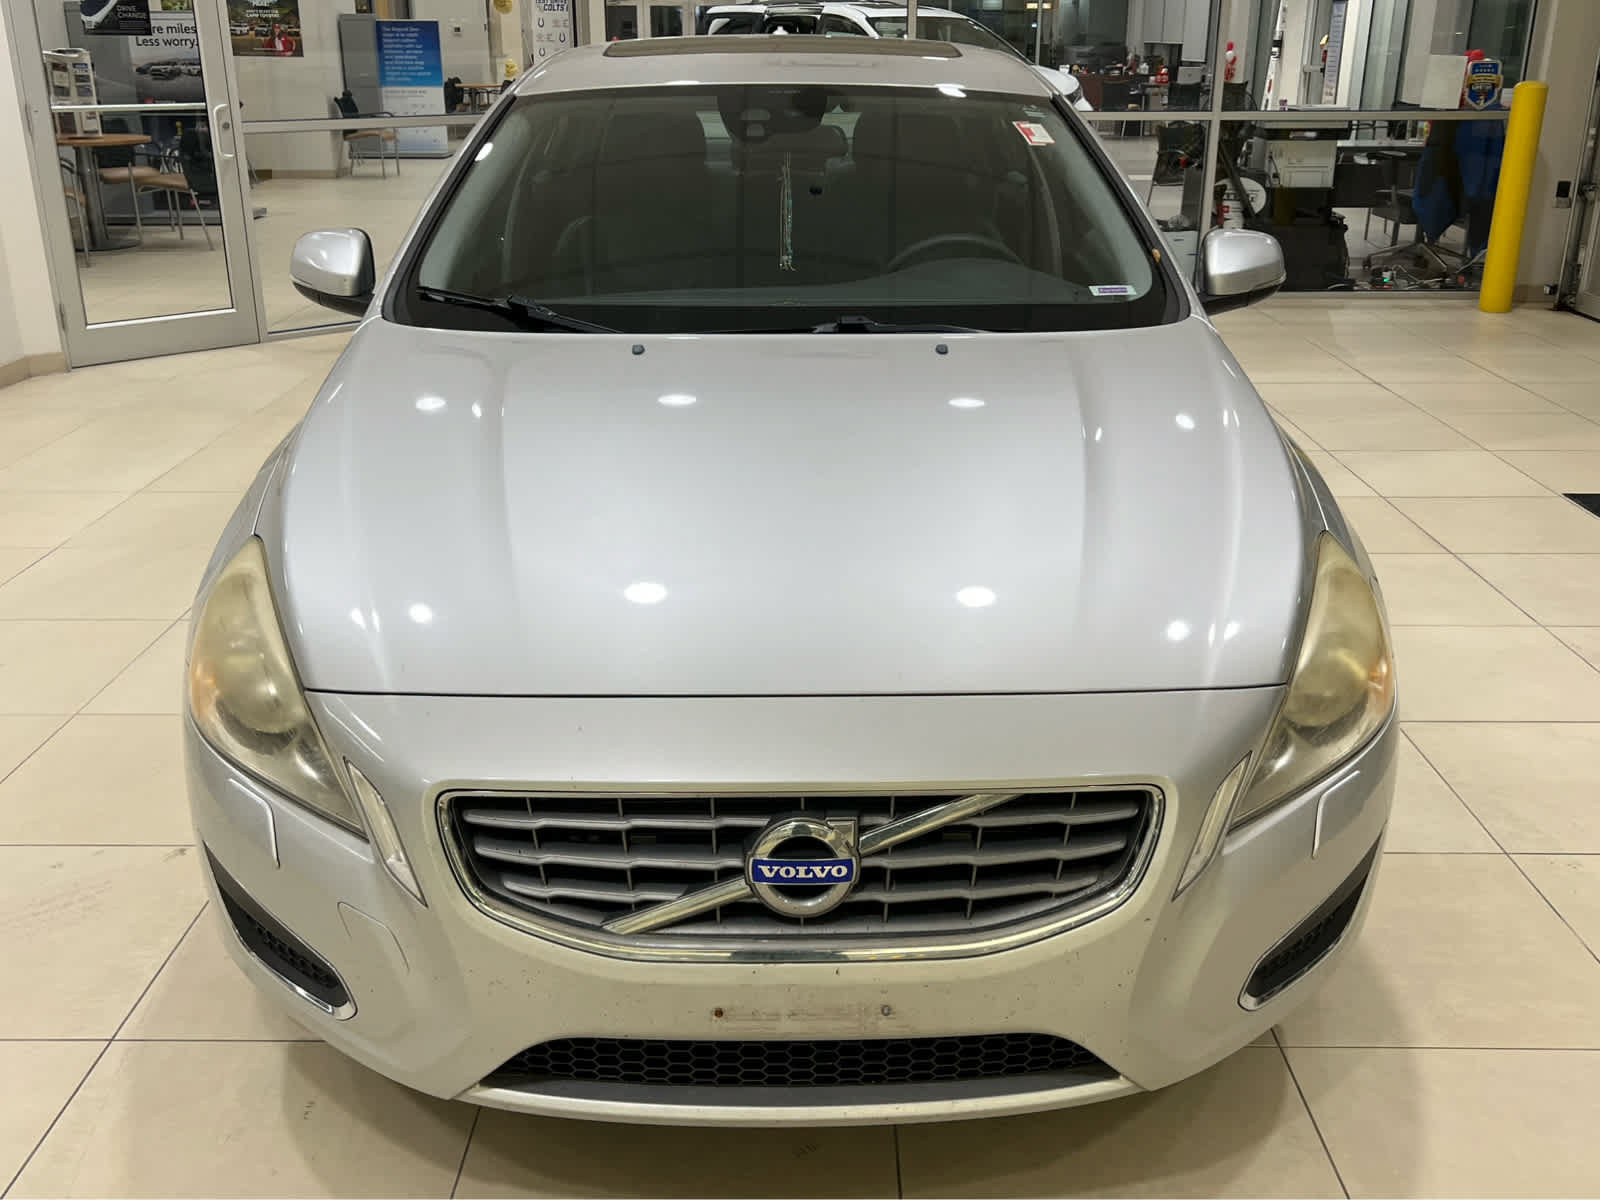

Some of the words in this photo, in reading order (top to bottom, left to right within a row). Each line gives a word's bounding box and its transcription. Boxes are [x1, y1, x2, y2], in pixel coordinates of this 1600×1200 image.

[544, 3, 565, 12] COLTS
[152, 25, 164, 34] re
[166, 23, 197, 34] miles
[135, 36, 160, 47] Less
[757, 865, 848, 878] VOLVO
